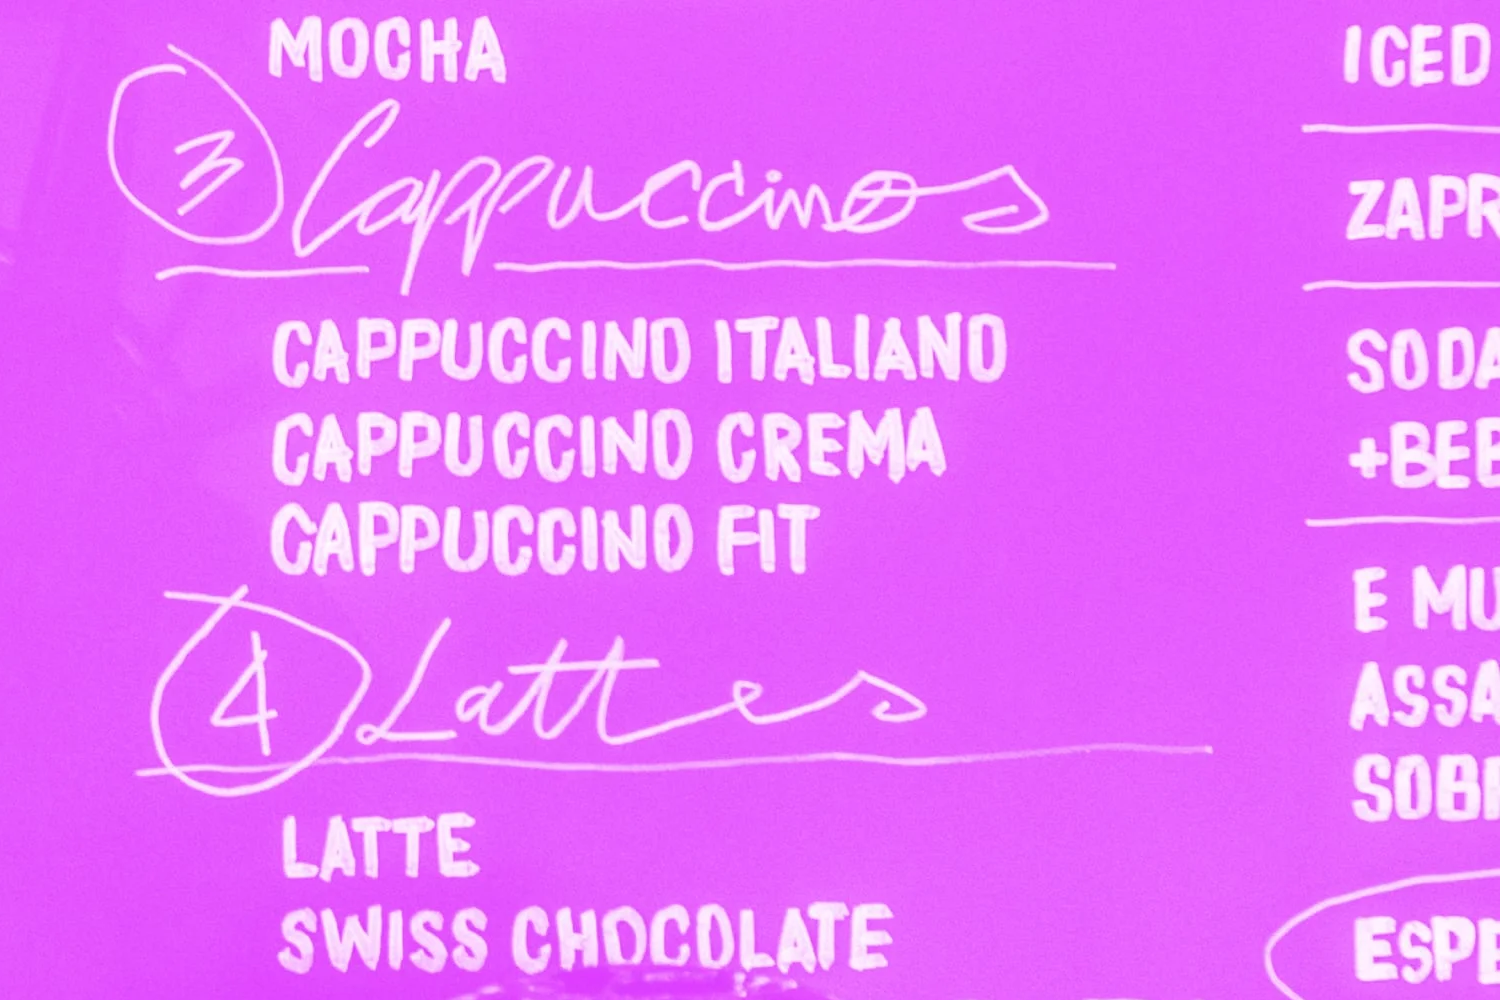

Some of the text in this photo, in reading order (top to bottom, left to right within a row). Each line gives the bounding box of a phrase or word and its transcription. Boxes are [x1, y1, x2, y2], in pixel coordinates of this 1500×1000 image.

[268, 15, 507, 84] MOCHA
[1343, 23, 1491, 87] ICED
[174, 98, 1052, 296] 3 Cappuccinos
[1346, 173, 1500, 240] ZAPR
[272, 312, 1007, 388] CAPPUCCINO ITALIANO
[1346, 326, 1500, 394] SODA
[271, 406, 947, 486] CAPPUCCINO CREMA
[270, 500, 820, 577] CAPPUCCINO FIT
[1352, 566, 1388, 633] E
[210, 618, 928, 756] 4 Lattes
[1349, 659, 1500, 731] ASSA
[282, 812, 480, 882] LATTE
[278, 901, 894, 974] SWISS CHOCOLATE
